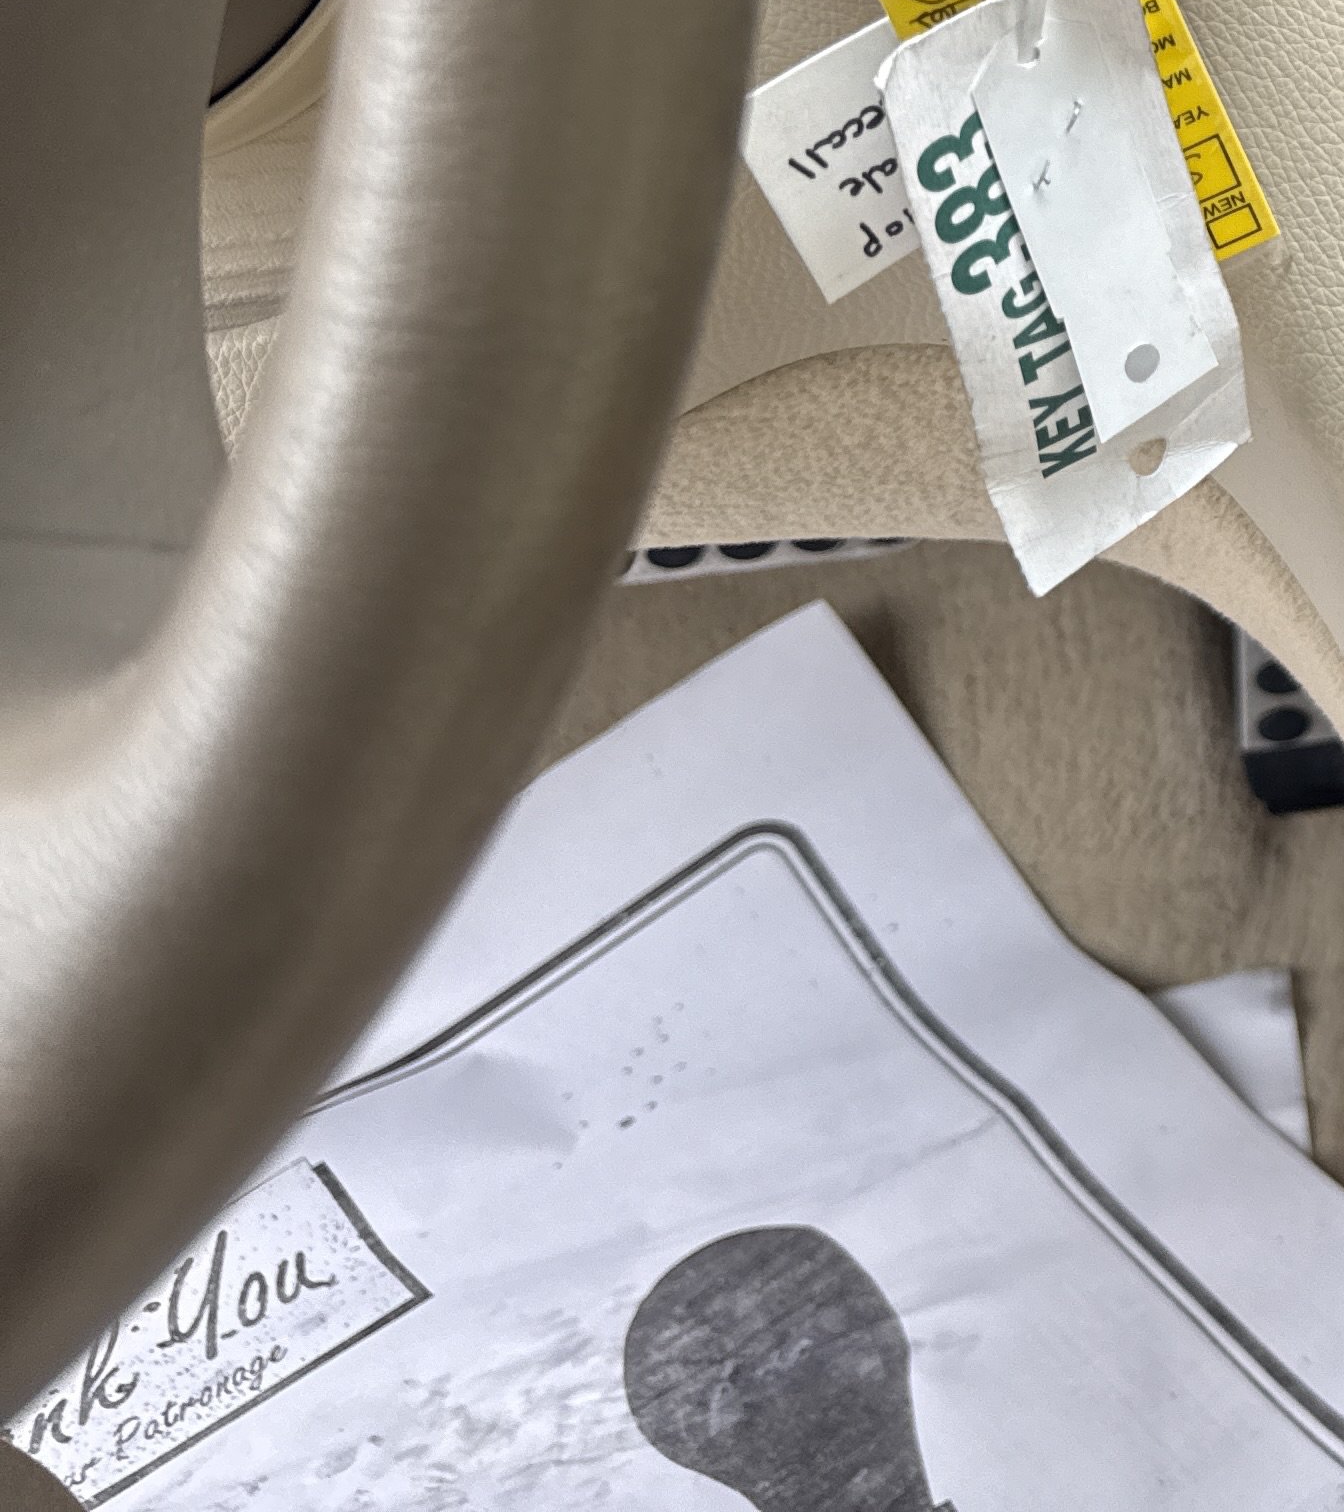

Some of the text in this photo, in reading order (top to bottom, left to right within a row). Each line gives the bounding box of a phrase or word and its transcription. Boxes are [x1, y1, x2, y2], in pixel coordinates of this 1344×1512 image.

[788, 90, 885, 179] ecall
[917, 110, 1031, 296] 383
[1203, 190, 1246, 220] NEW
[1001, 272, 1072, 386] TAG
[1028, 384, 1098, 479] KEY
[114, 1345, 288, 1461] Patronage
